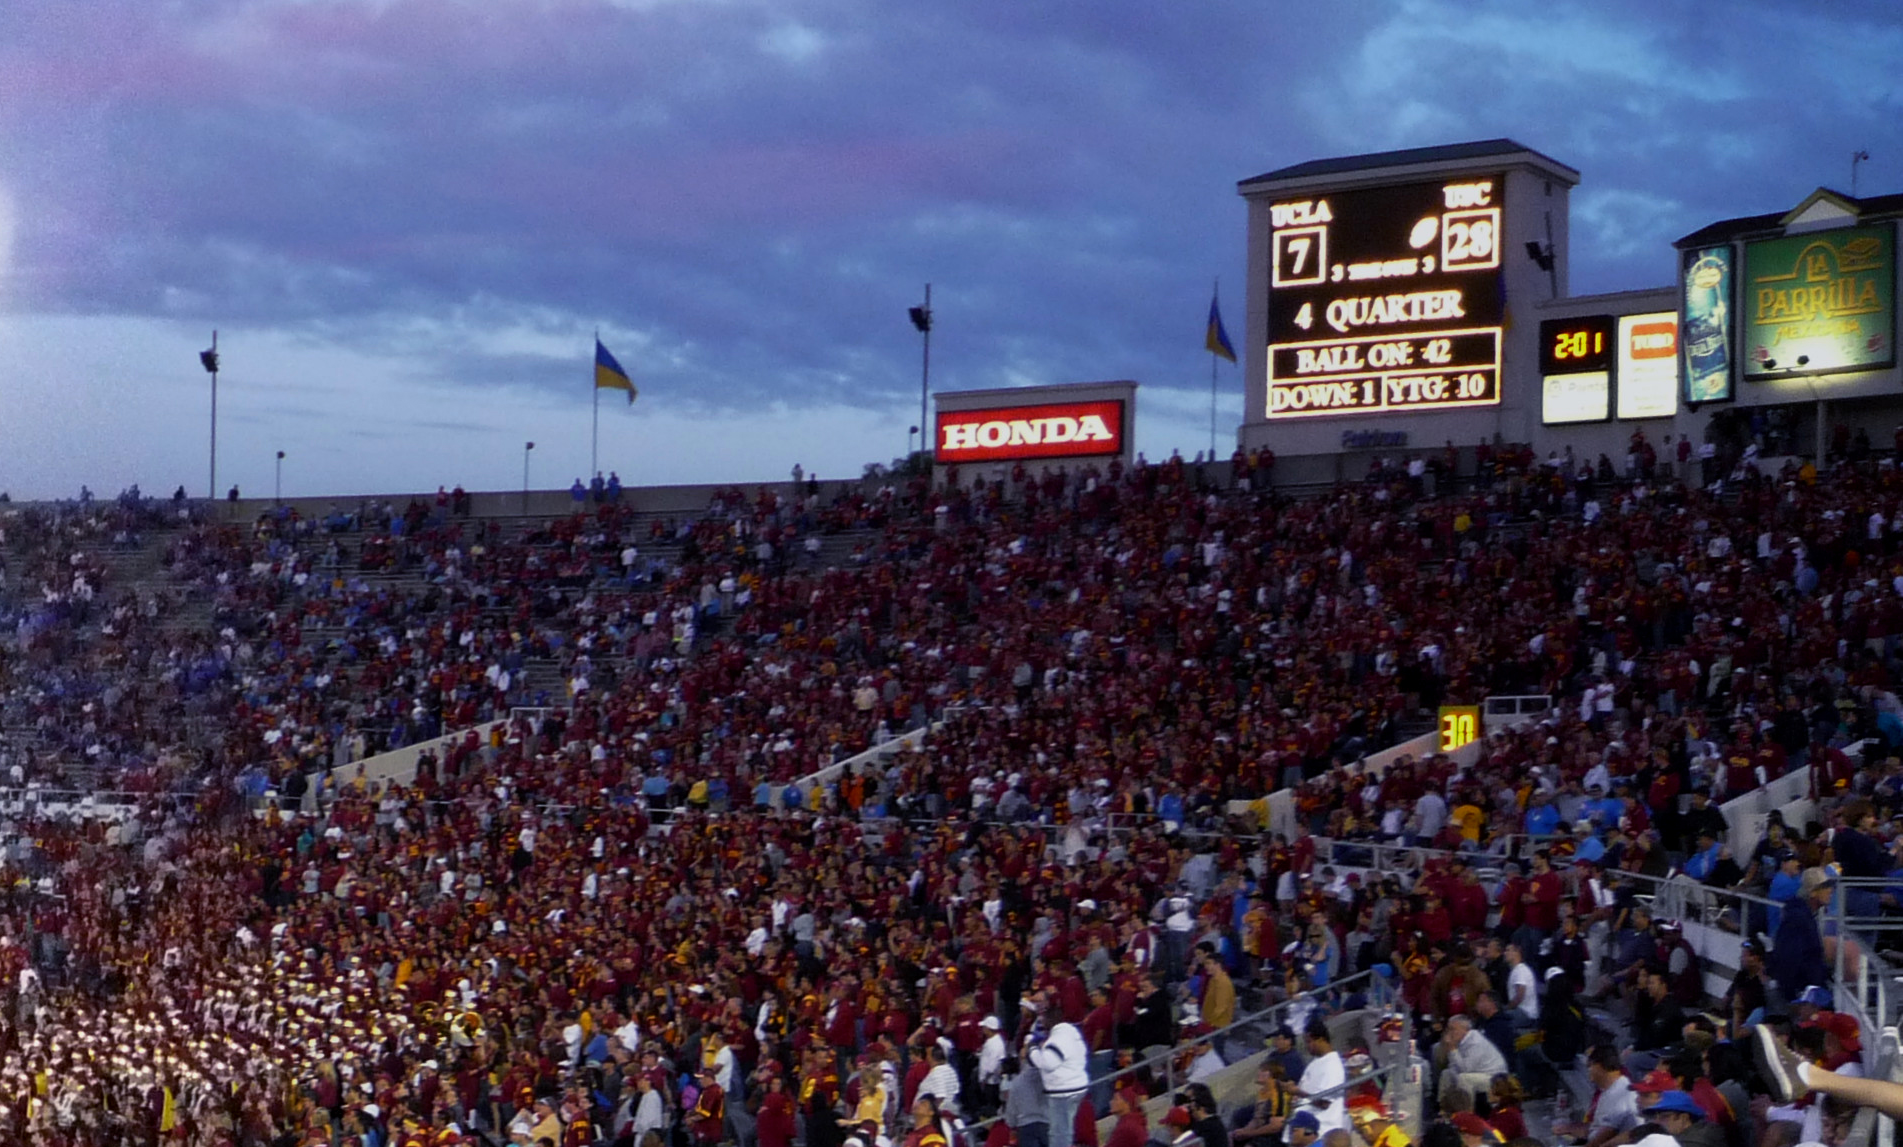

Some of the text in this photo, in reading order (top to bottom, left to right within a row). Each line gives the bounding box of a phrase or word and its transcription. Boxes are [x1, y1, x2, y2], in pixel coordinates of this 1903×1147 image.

[1271, 201, 1332, 227] UCLA
[1288, 222, 1493, 273] 7 28
[1806, 253, 1830, 283] LA
[1294, 290, 1464, 331] 4 QUARTER
[1758, 282, 1883, 320] PARRILLA
[1296, 340, 1452, 374] BALL ON: 42
[1555, 332, 1601, 359] 2:01
[1271, 373, 1486, 410] DOWN: 1 YTG: 10
[942, 415, 1114, 450] HONDA
